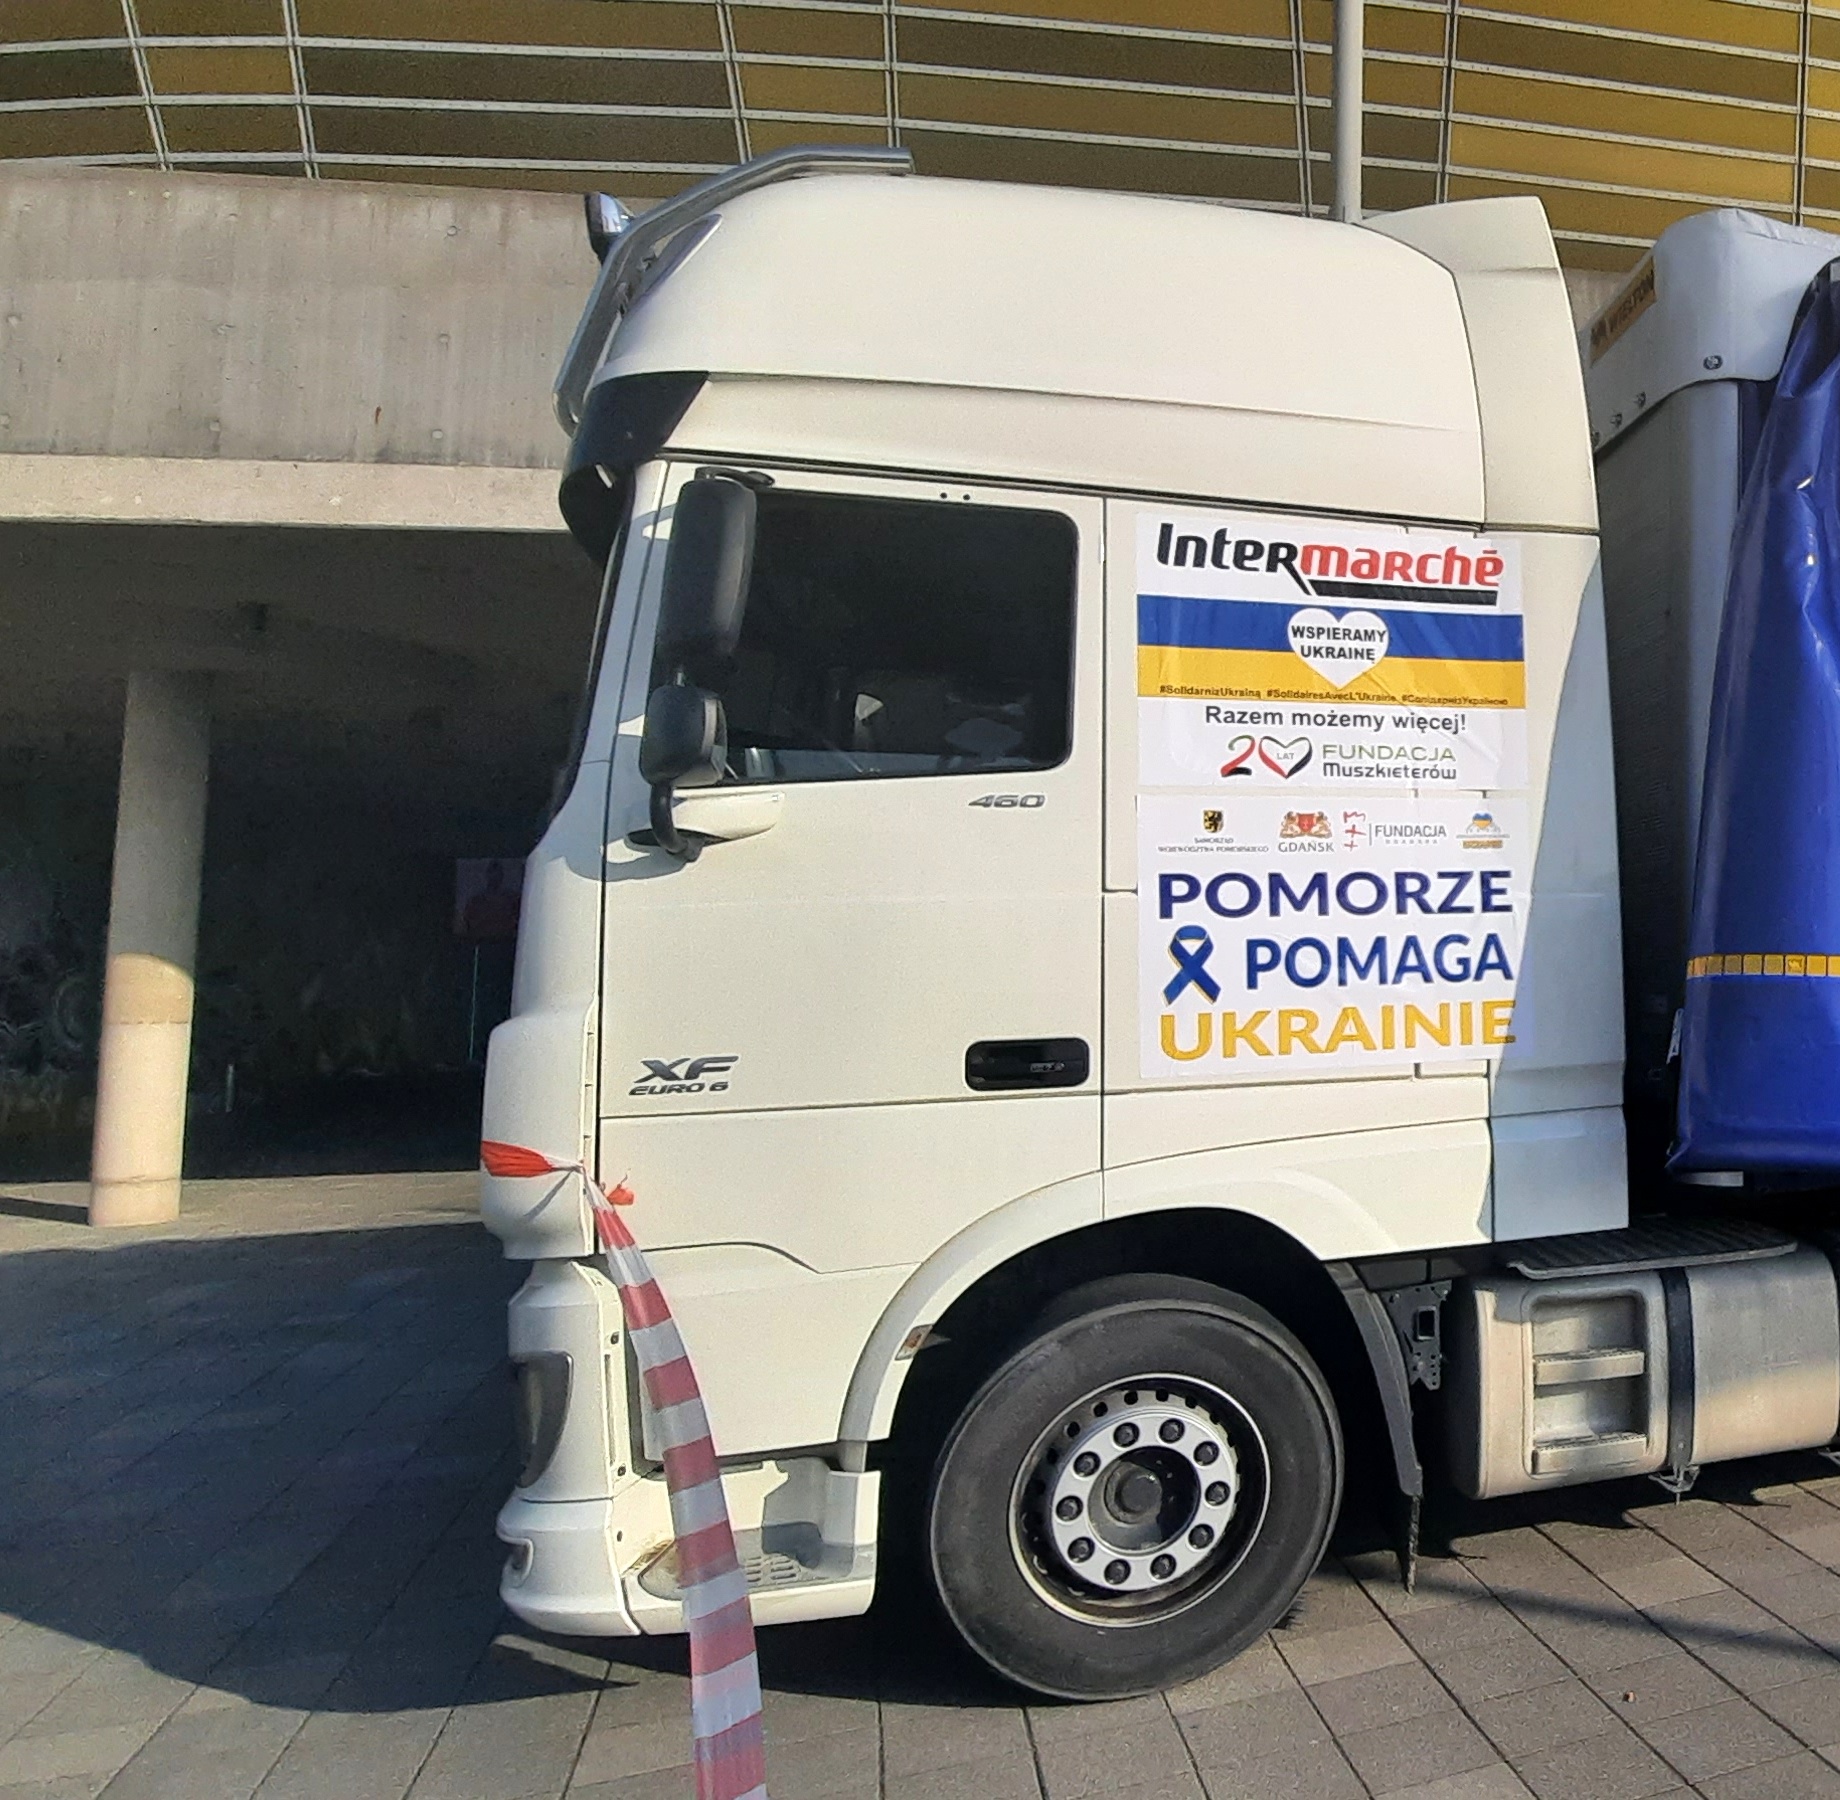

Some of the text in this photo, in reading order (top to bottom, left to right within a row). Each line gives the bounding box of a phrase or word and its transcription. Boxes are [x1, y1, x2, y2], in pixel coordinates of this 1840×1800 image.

[1157, 523, 1503, 592] Intermarché
[1291, 625, 1387, 644] WSPIERAMY
[1300, 645, 1376, 664] UKRAINĘ
[1205, 706, 1466, 735] Razem możemy więcej!
[1322, 744, 1456, 763] FUNDACJA
[1322, 762, 1457, 780] Muszkieterów
[968, 794, 1046, 808] 460
[1374, 824, 1447, 838] FUNDACJA
[1277, 839, 1336, 853] GDAŃSK
[1158, 869, 1514, 920] POMORZE
[1245, 932, 1514, 990] POMAGA
[1160, 999, 1517, 1062] UKRAINIE
[634, 1055, 740, 1084] XF
[628, 1081, 729, 1096] EURO 6
